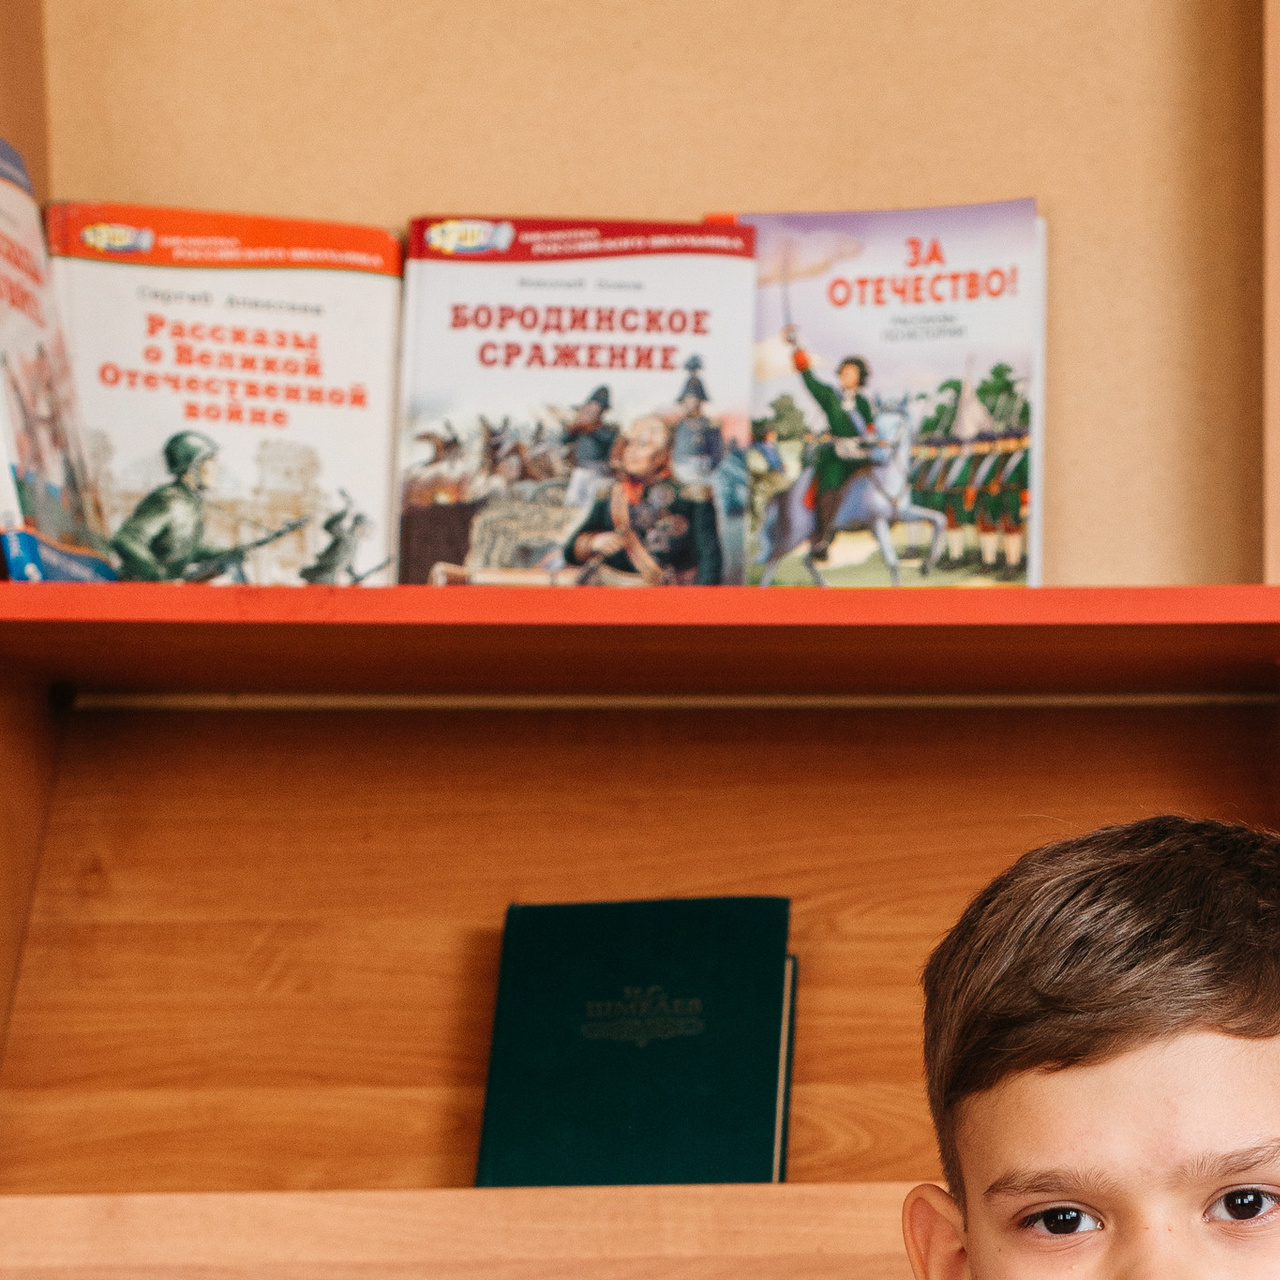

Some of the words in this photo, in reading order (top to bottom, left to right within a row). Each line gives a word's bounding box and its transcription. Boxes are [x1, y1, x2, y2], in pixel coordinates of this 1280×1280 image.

[905, 236, 947, 268] ЗА
[826, 265, 1018, 308] ОТЕЧЕСТВО!
[145, 313, 320, 350] Рассказы
[449, 303, 711, 337] БОРОДИНСКОЕ
[144, 345, 162, 364] о
[174, 342, 323, 378] Великой
[478, 341, 679, 371] СРАЖЕНИЕ
[98, 362, 369, 410] Отечественной
[182, 399, 289, 428] войне
